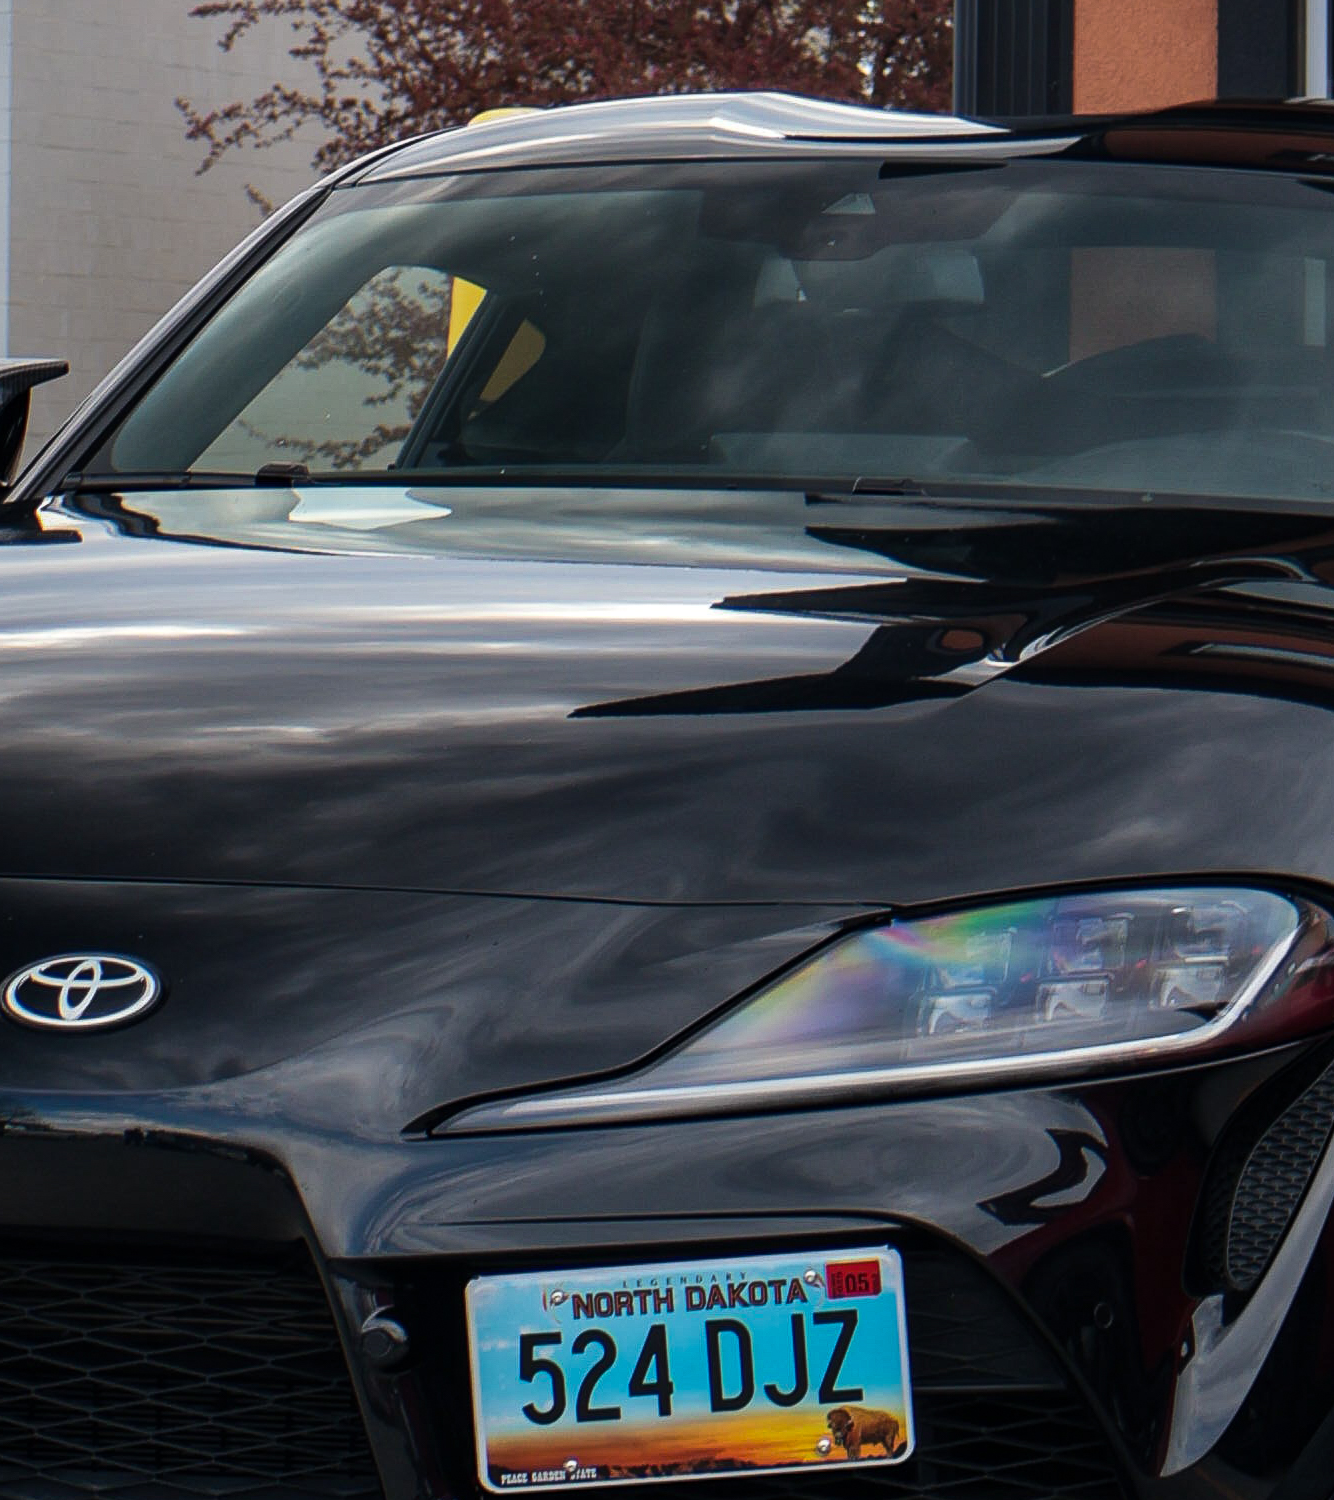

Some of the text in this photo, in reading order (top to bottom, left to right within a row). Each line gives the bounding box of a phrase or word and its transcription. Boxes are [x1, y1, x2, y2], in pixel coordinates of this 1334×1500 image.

[622, 1271, 748, 1290] LEGENDARY
[571, 1285, 675, 1321] NORTH
[684, 1277, 809, 1313] DAKOTA
[518, 1308, 864, 1426] 524 DJZ
[531, 1469, 567, 1483] GARDEN
